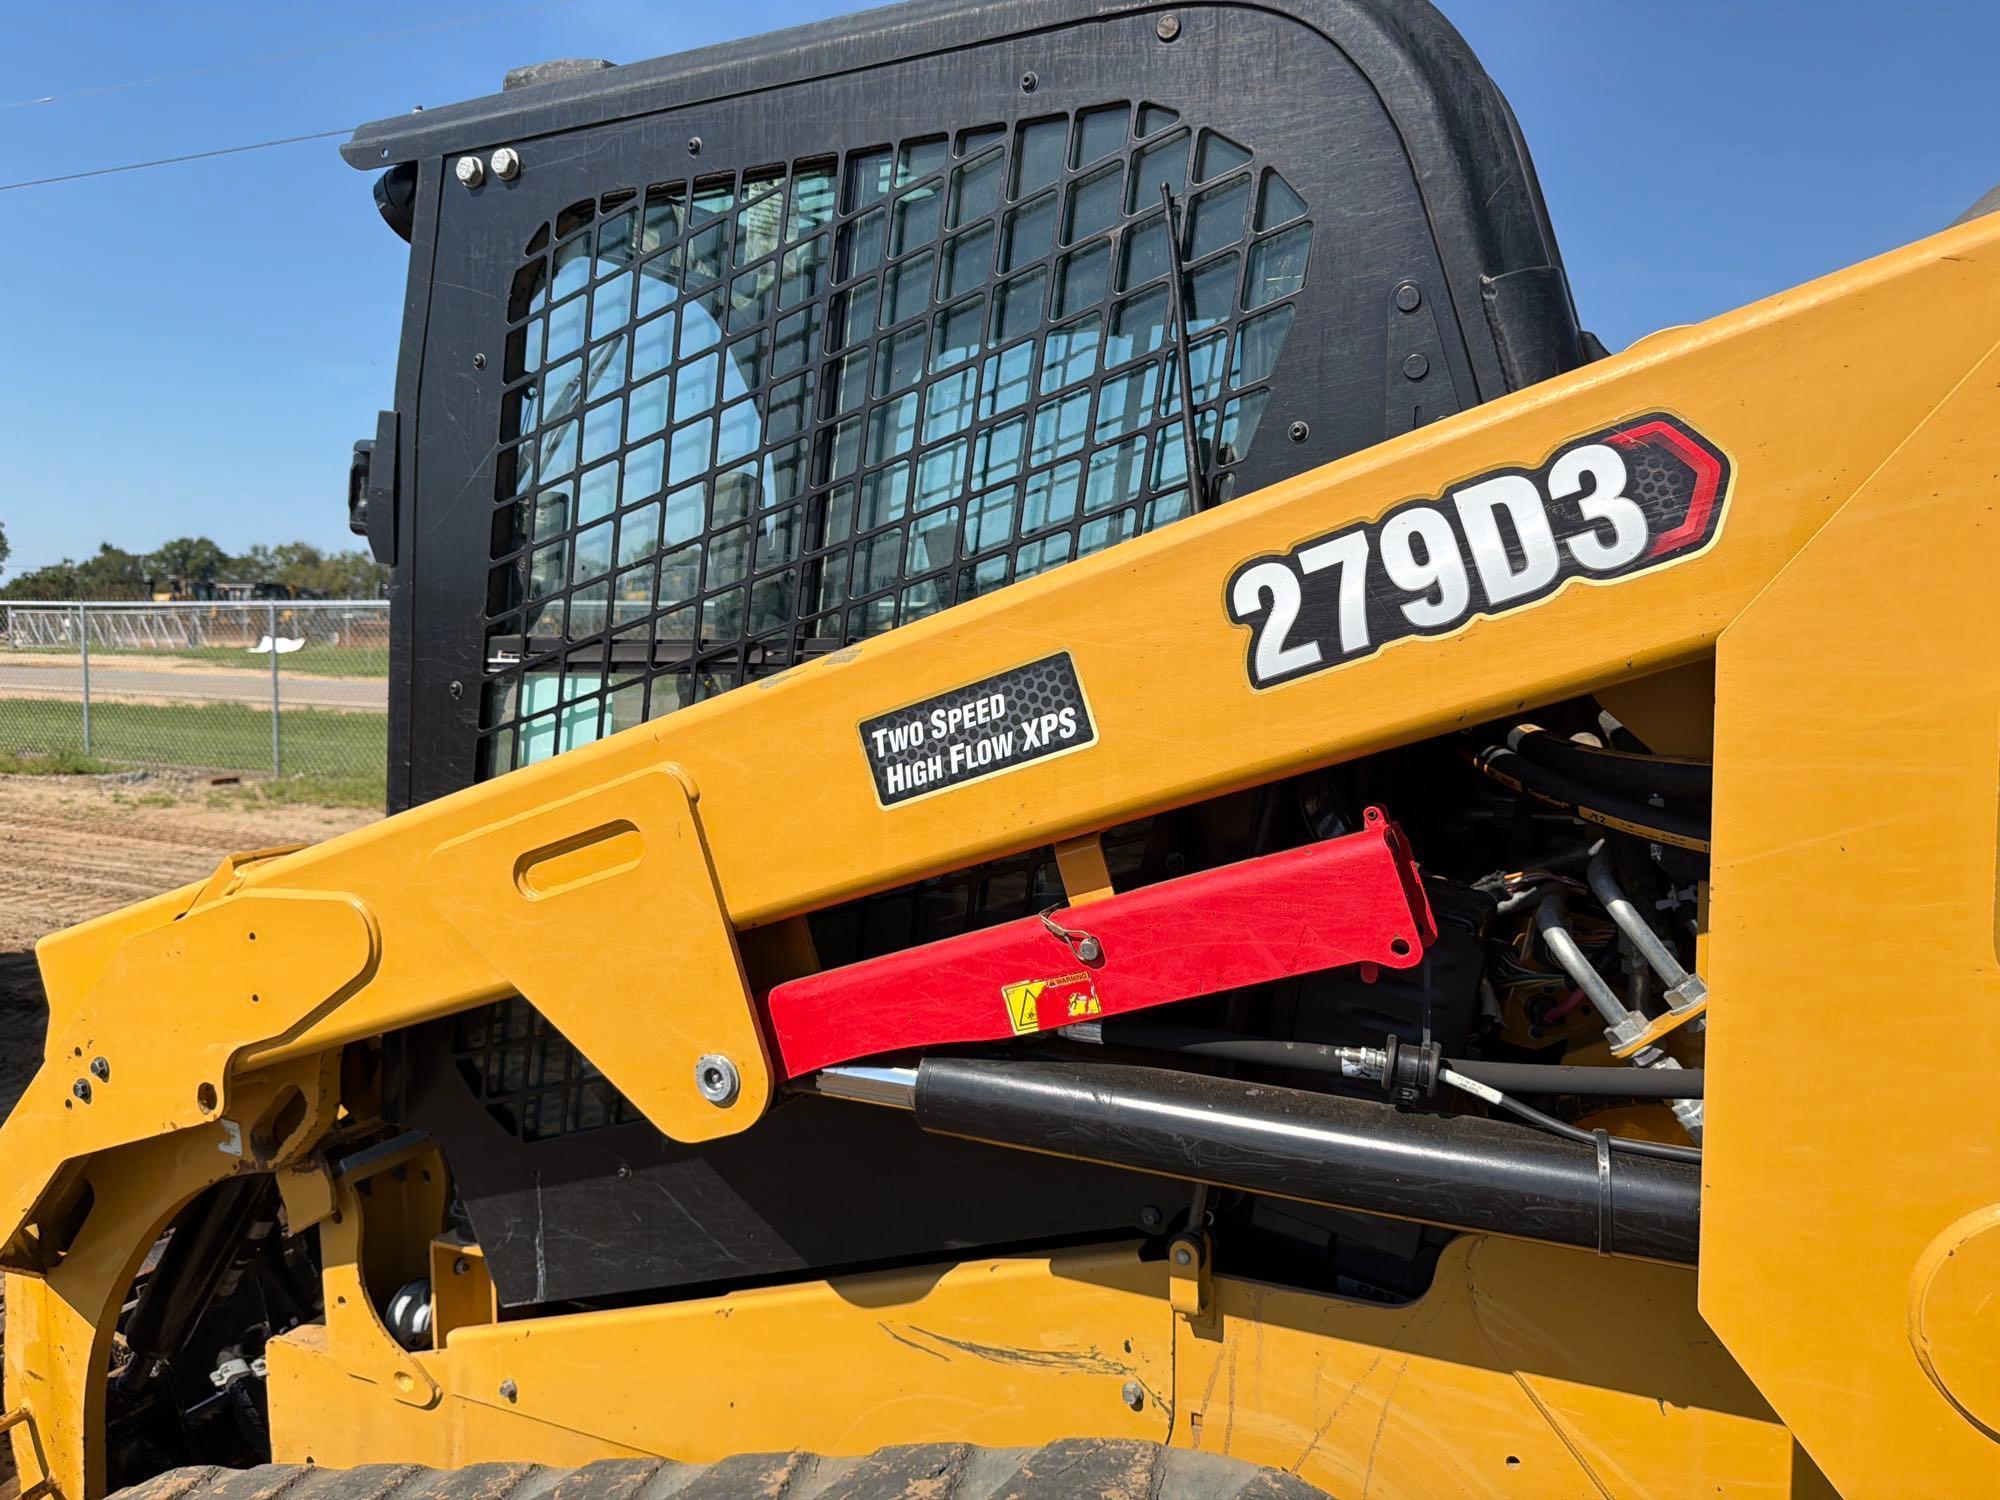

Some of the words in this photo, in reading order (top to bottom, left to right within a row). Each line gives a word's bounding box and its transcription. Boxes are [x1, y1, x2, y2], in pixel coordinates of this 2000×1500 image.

[1233, 444, 1649, 682] 279D3
[1021, 706, 1077, 751] XPS
[1056, 972, 1087, 985] WARNING
